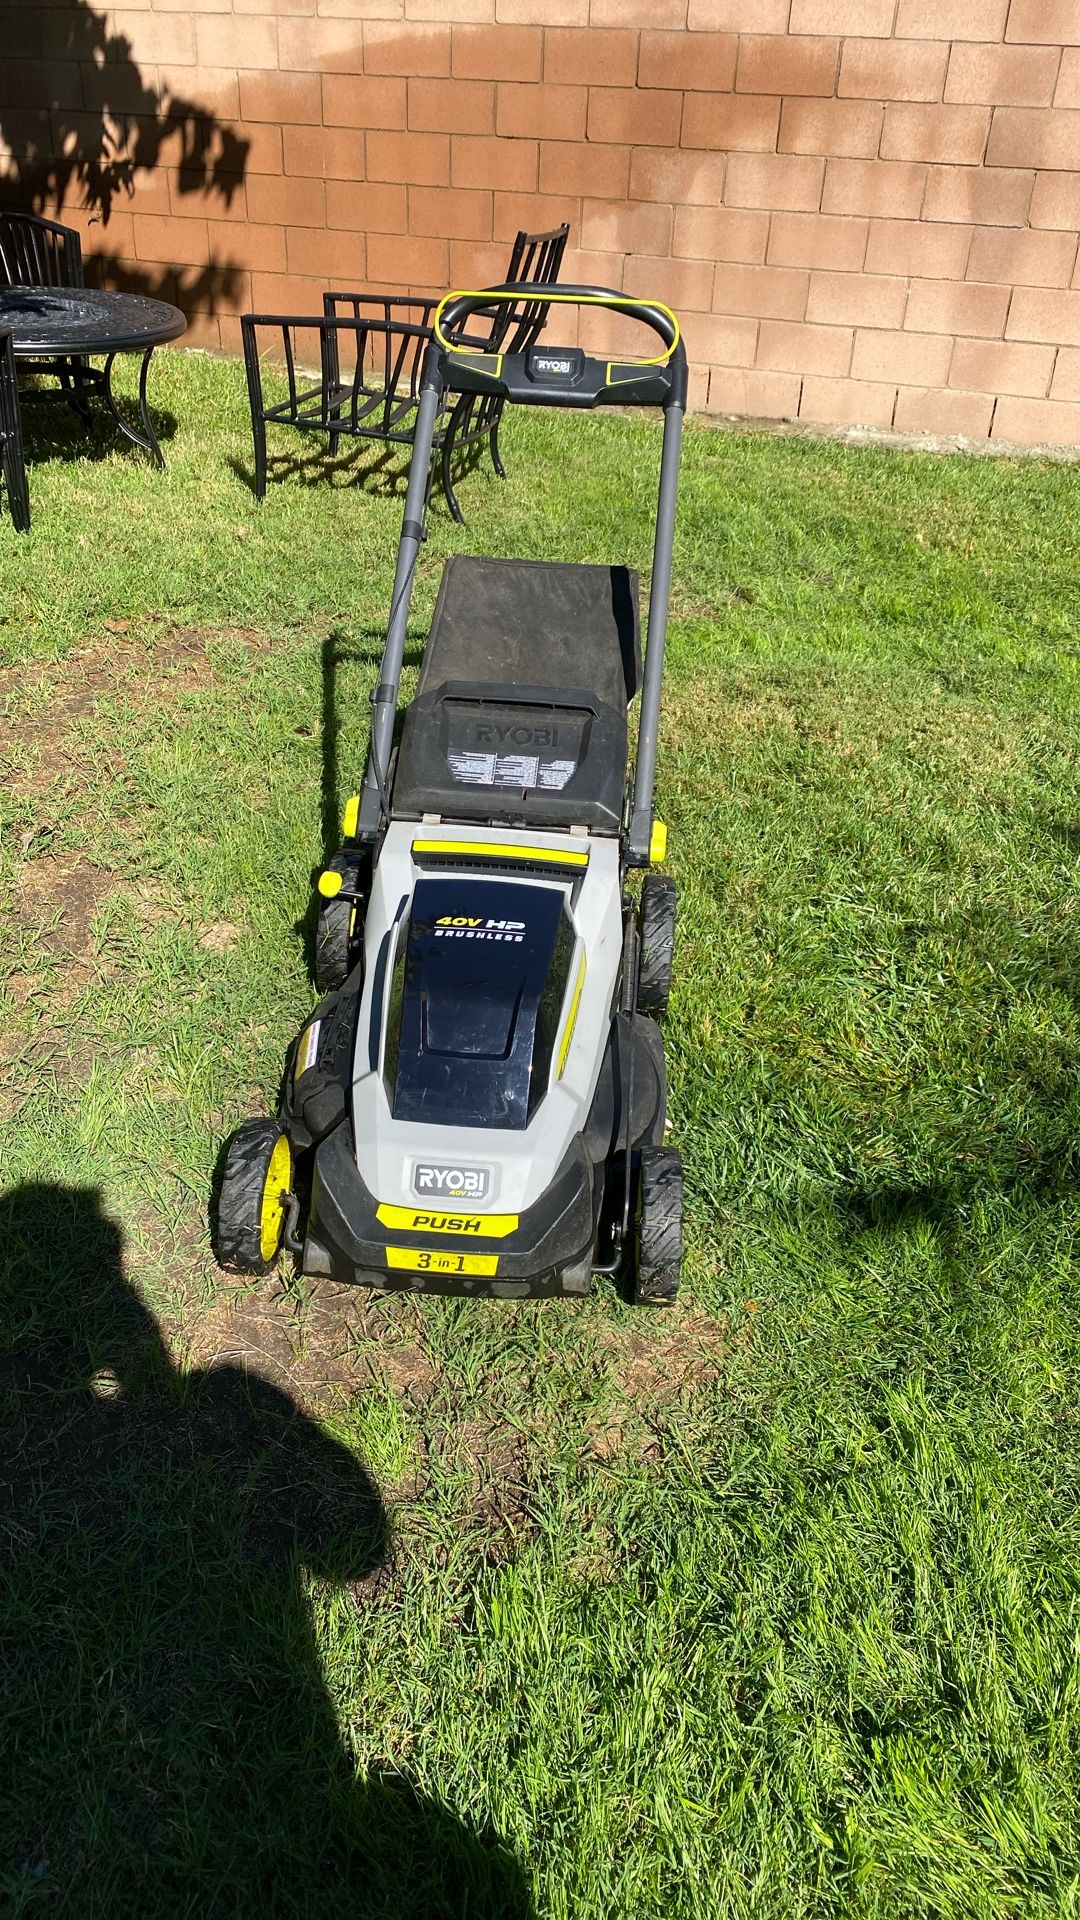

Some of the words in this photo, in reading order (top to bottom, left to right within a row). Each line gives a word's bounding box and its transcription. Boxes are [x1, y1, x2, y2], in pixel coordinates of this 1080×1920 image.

[538, 360, 570, 371] RYOBI
[475, 723, 560, 748] RYOBI
[435, 916, 484, 927] 40V
[485, 919, 526, 930] HP
[434, 929, 524, 942] BRUSHLESS
[418, 1168, 485, 1191] RYOBI
[449, 1189, 466, 1197] 40V
[467, 1190, 483, 1198] HP
[412, 1215, 482, 1232] PUSH
